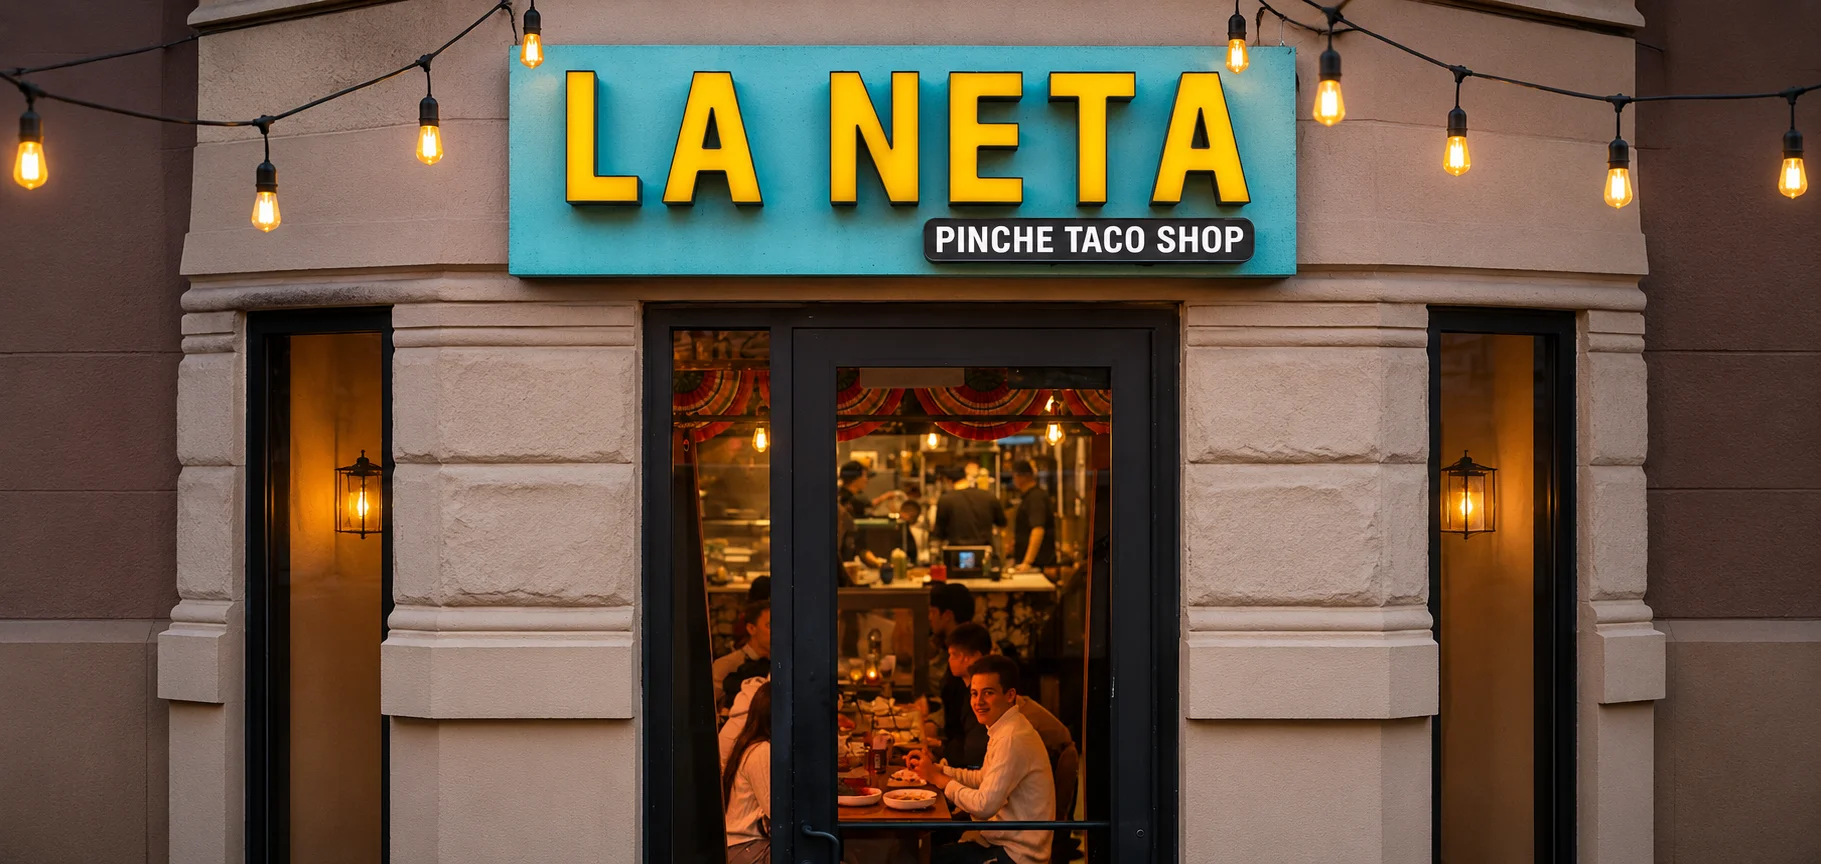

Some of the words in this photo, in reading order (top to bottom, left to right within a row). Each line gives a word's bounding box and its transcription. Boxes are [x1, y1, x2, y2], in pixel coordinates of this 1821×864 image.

[565, 71, 763, 206] LA
[829, 71, 1251, 206] NETA
[935, 225, 1055, 253] PINCHE
[1064, 225, 1146, 253] TACO
[1156, 225, 1245, 253] SHOP
